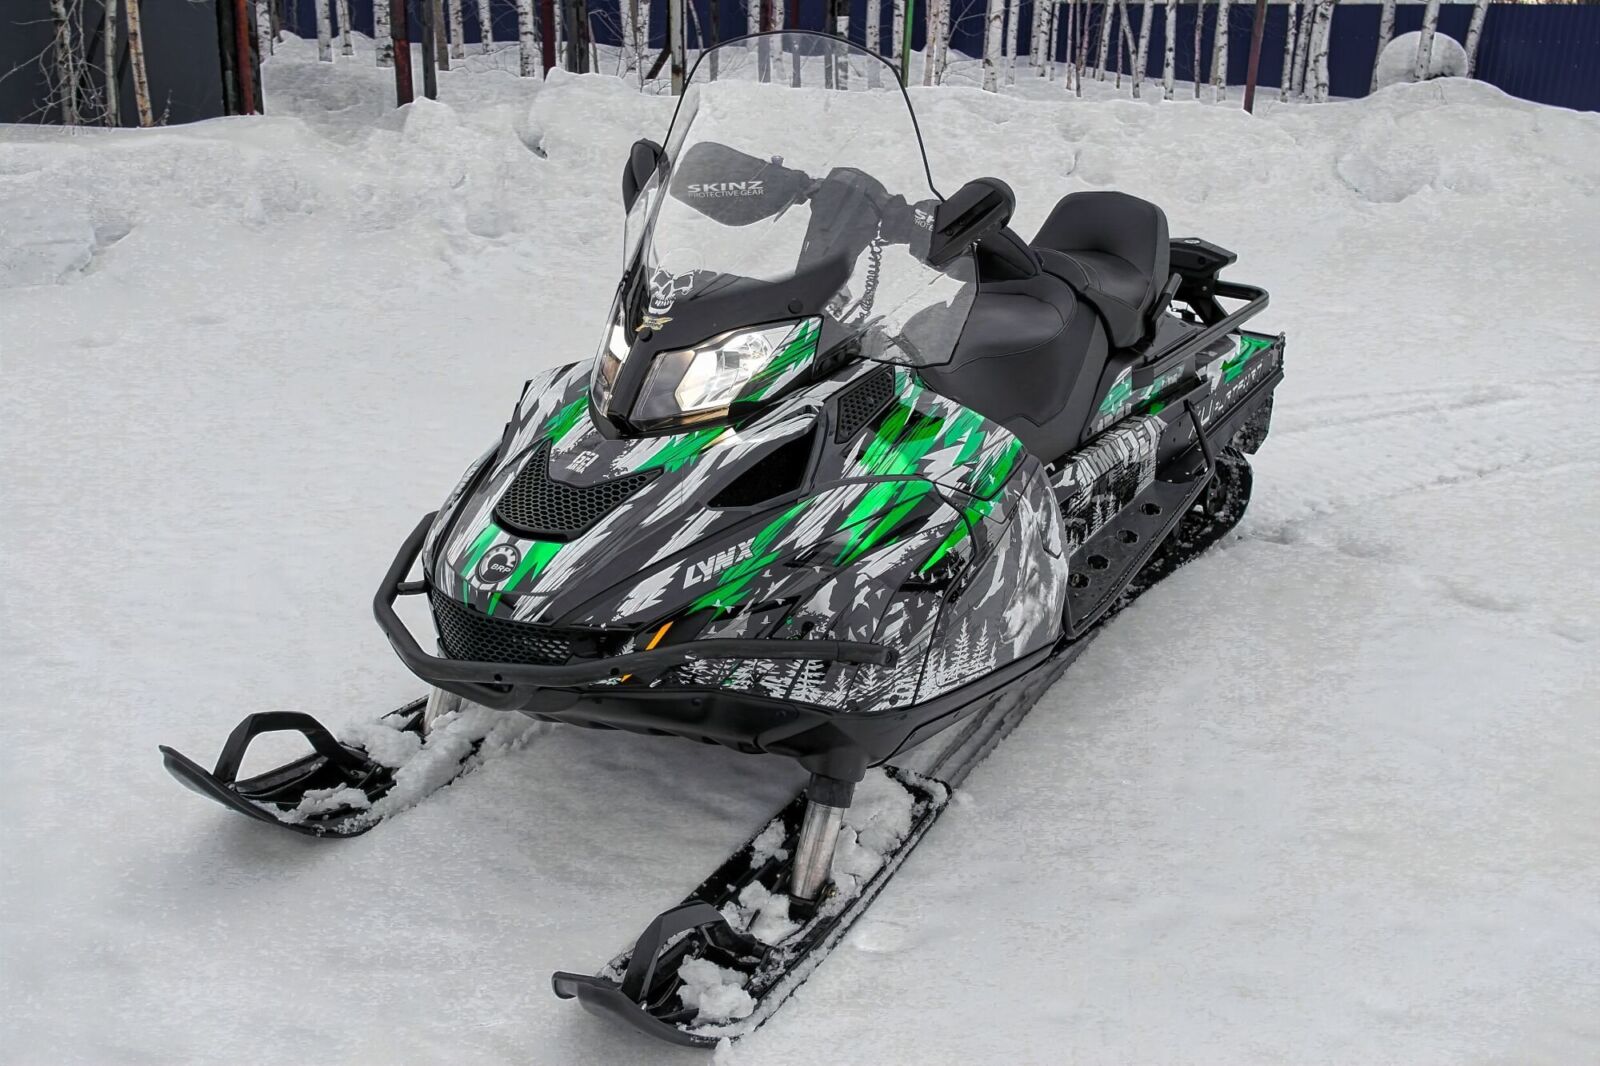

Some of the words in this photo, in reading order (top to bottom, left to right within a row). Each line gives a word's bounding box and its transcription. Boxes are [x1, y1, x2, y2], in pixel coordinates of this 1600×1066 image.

[687, 180, 764, 193] SKINZ
[688, 190, 740, 199] PROTECTIVE
[740, 188, 765, 196] GEAR
[490, 563, 511, 573] BRP
[682, 536, 756, 590] LYNX
